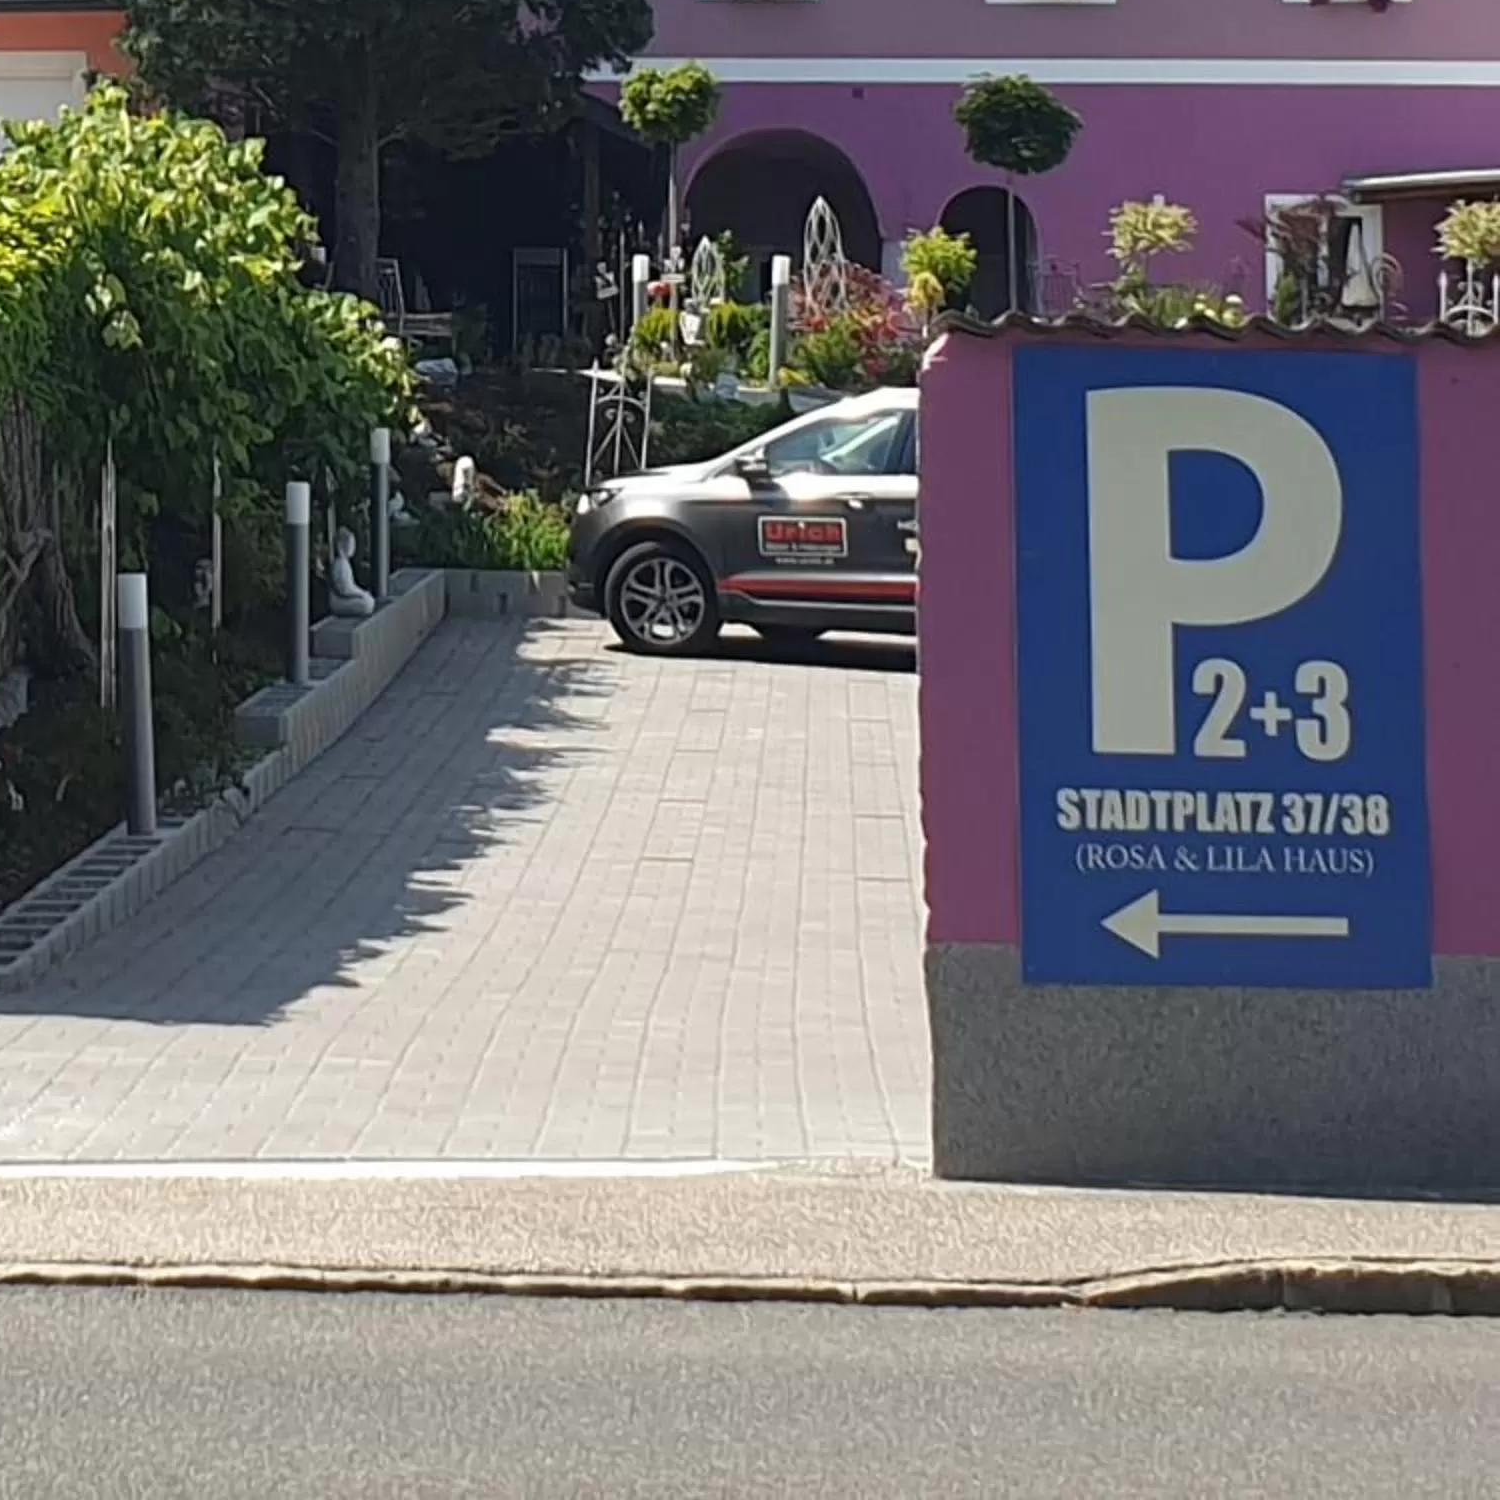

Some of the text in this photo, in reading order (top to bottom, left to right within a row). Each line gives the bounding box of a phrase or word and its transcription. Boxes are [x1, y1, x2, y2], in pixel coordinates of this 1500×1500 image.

[1085, 386, 1342, 755] P
[1192, 657, 1351, 762] 2+3
[1056, 788, 1391, 835] STADTPLATZ 37/38
[1075, 843, 1375, 877] (ROSA & LILA HAUS)
